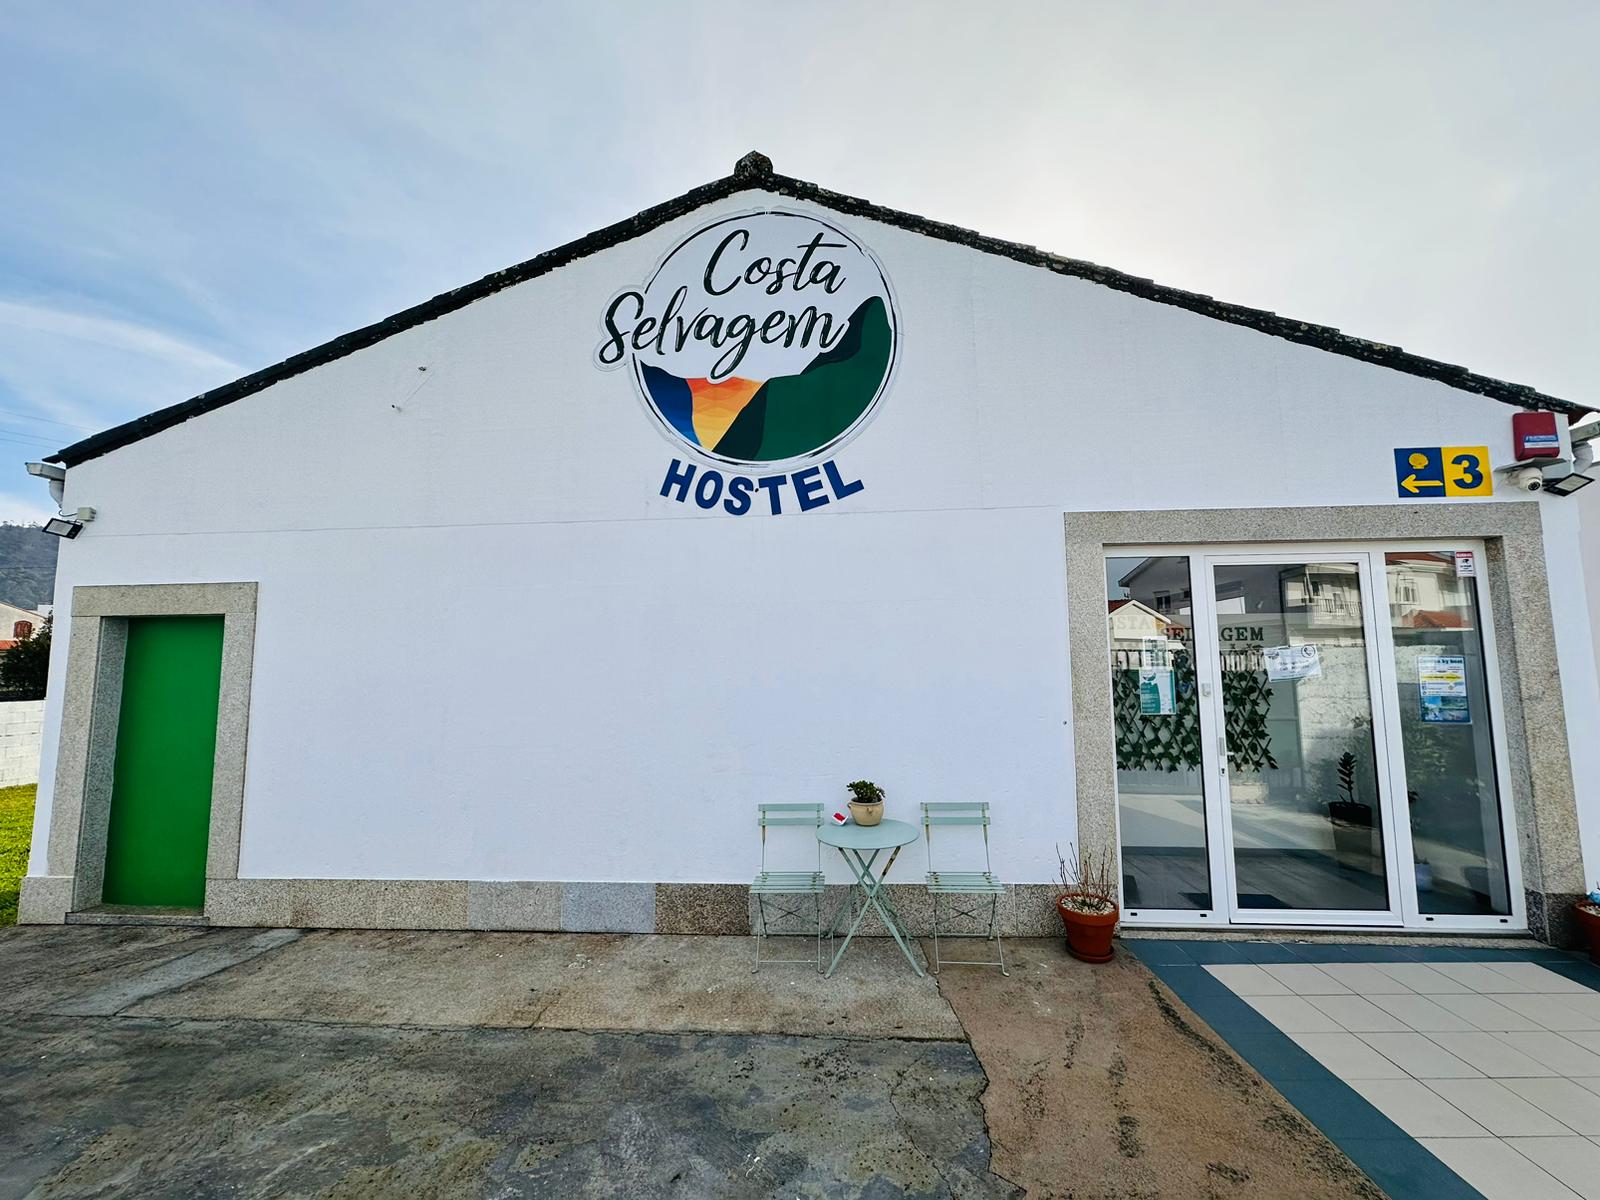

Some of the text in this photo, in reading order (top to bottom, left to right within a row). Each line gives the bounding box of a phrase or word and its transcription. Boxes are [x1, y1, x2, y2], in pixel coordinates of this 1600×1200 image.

[703, 229, 847, 296] Costa
[598, 285, 848, 380] Selvagem
[659, 458, 865, 516] HOSTEL
[1451, 453, 1484, 490] 3
